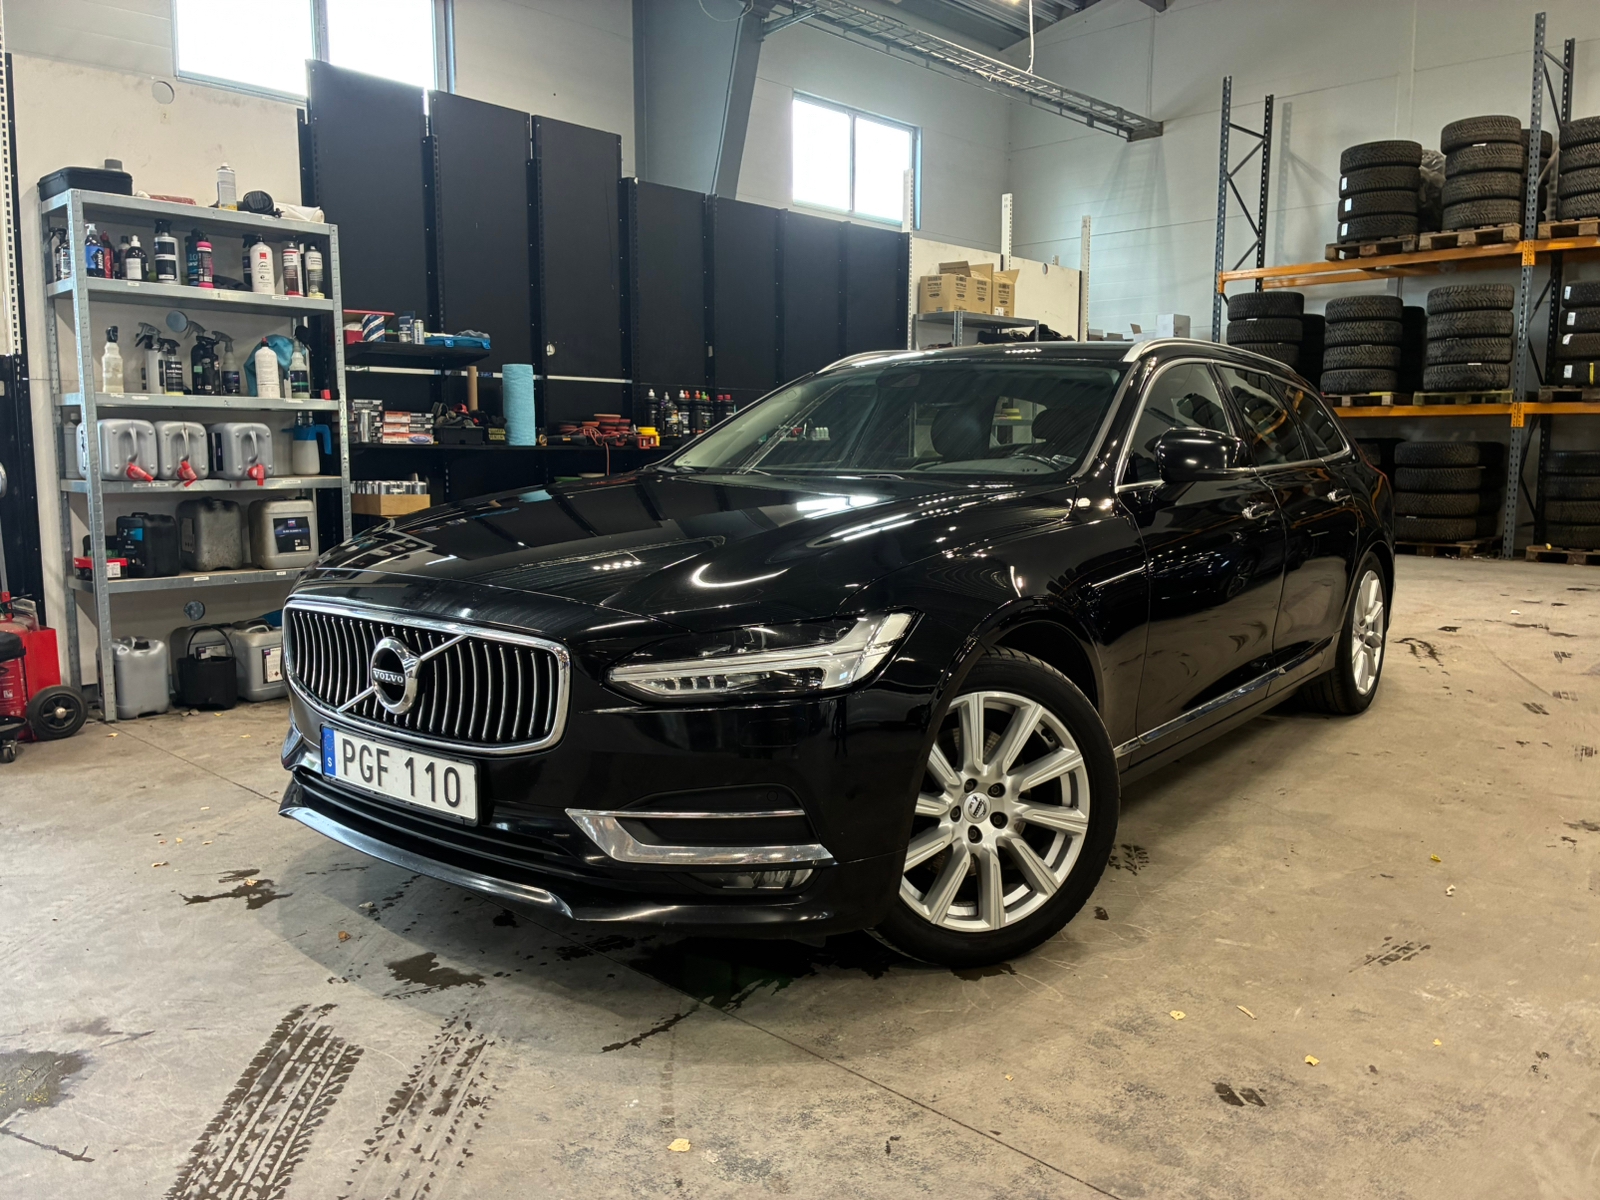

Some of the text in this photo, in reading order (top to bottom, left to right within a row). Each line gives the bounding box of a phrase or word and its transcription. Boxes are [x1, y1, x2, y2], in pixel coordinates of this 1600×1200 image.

[373, 670, 403, 683] VOLVO
[327, 757, 333, 767] S
[342, 738, 460, 808] PGF 110
